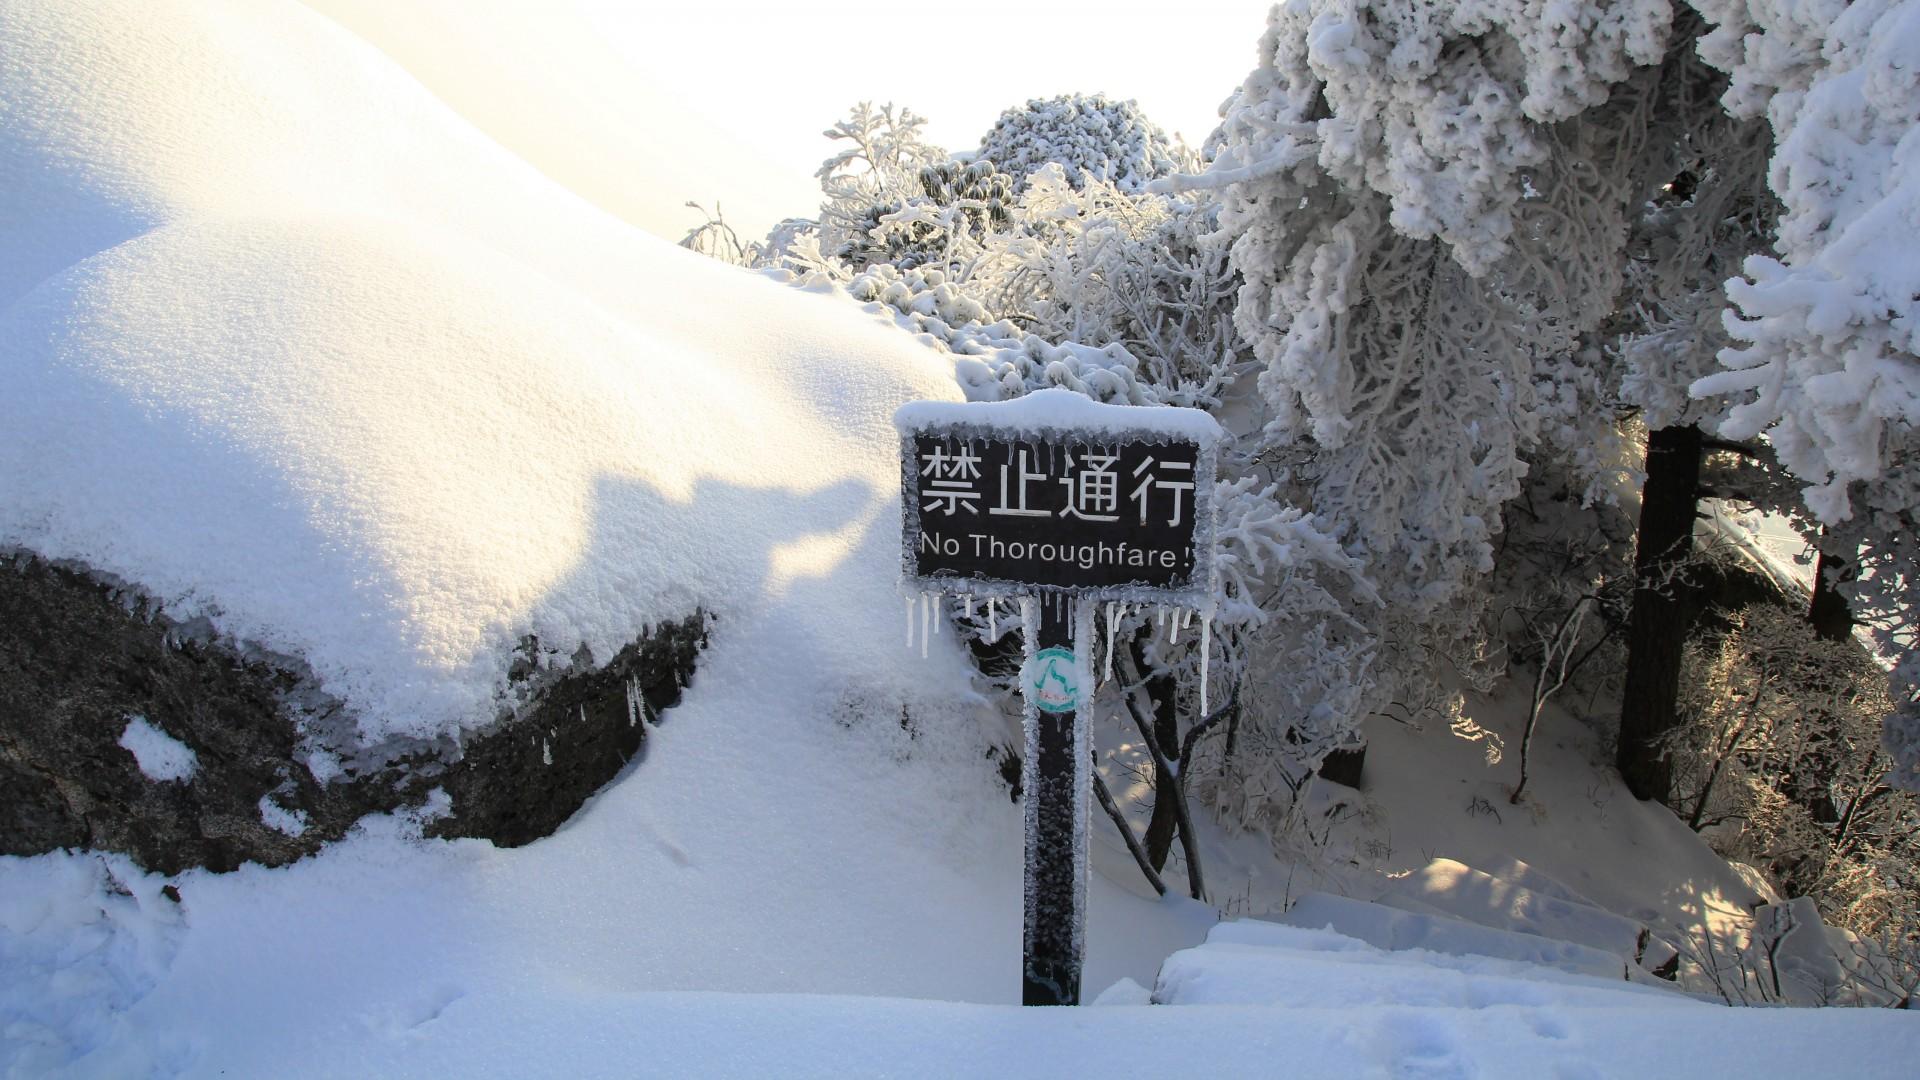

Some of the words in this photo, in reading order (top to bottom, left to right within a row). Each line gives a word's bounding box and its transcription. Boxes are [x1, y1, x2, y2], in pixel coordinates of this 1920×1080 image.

[921, 445, 1195, 528] 禁止通行
[920, 531, 960, 556] No
[968, 533, 1191, 570] Thoroughfare!
